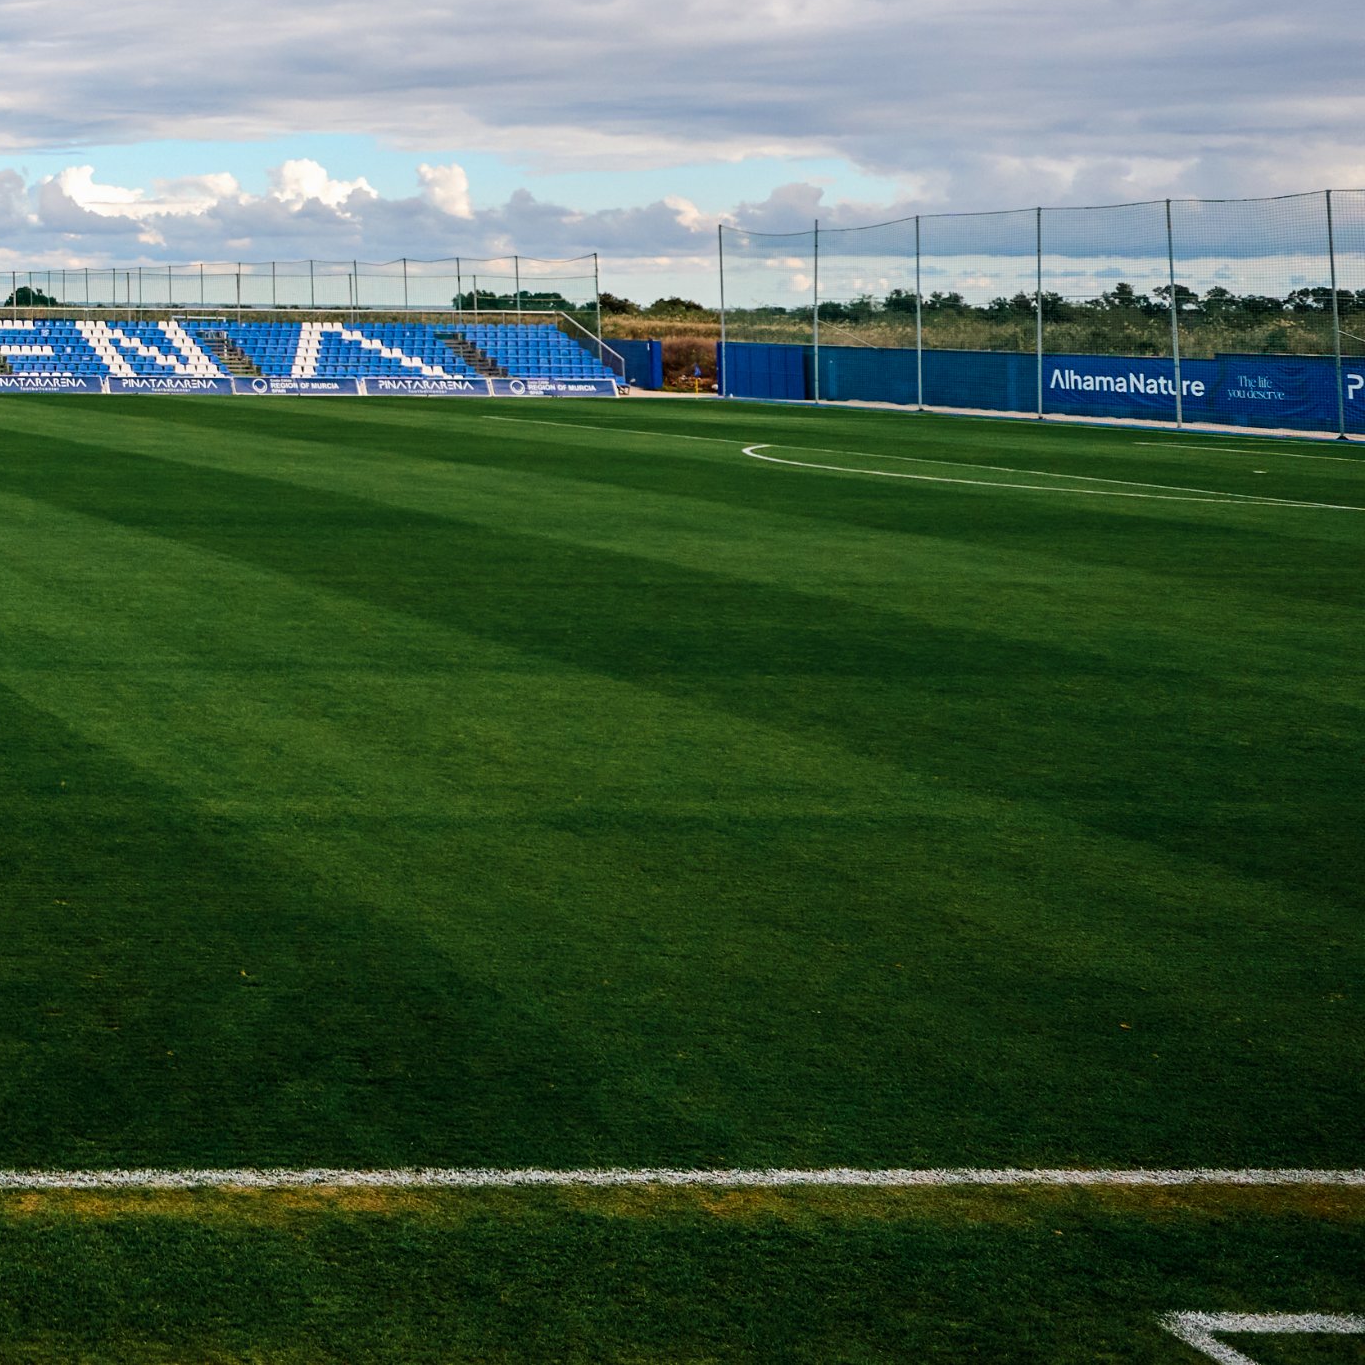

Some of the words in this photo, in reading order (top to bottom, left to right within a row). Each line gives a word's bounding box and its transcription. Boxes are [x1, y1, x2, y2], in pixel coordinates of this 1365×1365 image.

[122, 378, 218, 390] PINATARARENA
[270, 382, 298, 390] REGION
[300, 382, 311, 390] OF
[312, 383, 340, 391] MURCIA
[378, 380, 475, 391] PINATARARENA
[1050, 369, 1205, 397] AlhamaNature
[1237, 375, 1256, 387] The
[1258, 375, 1272, 388] life
[1227, 389, 1246, 400] you
[1246, 387, 1285, 400] deserve
